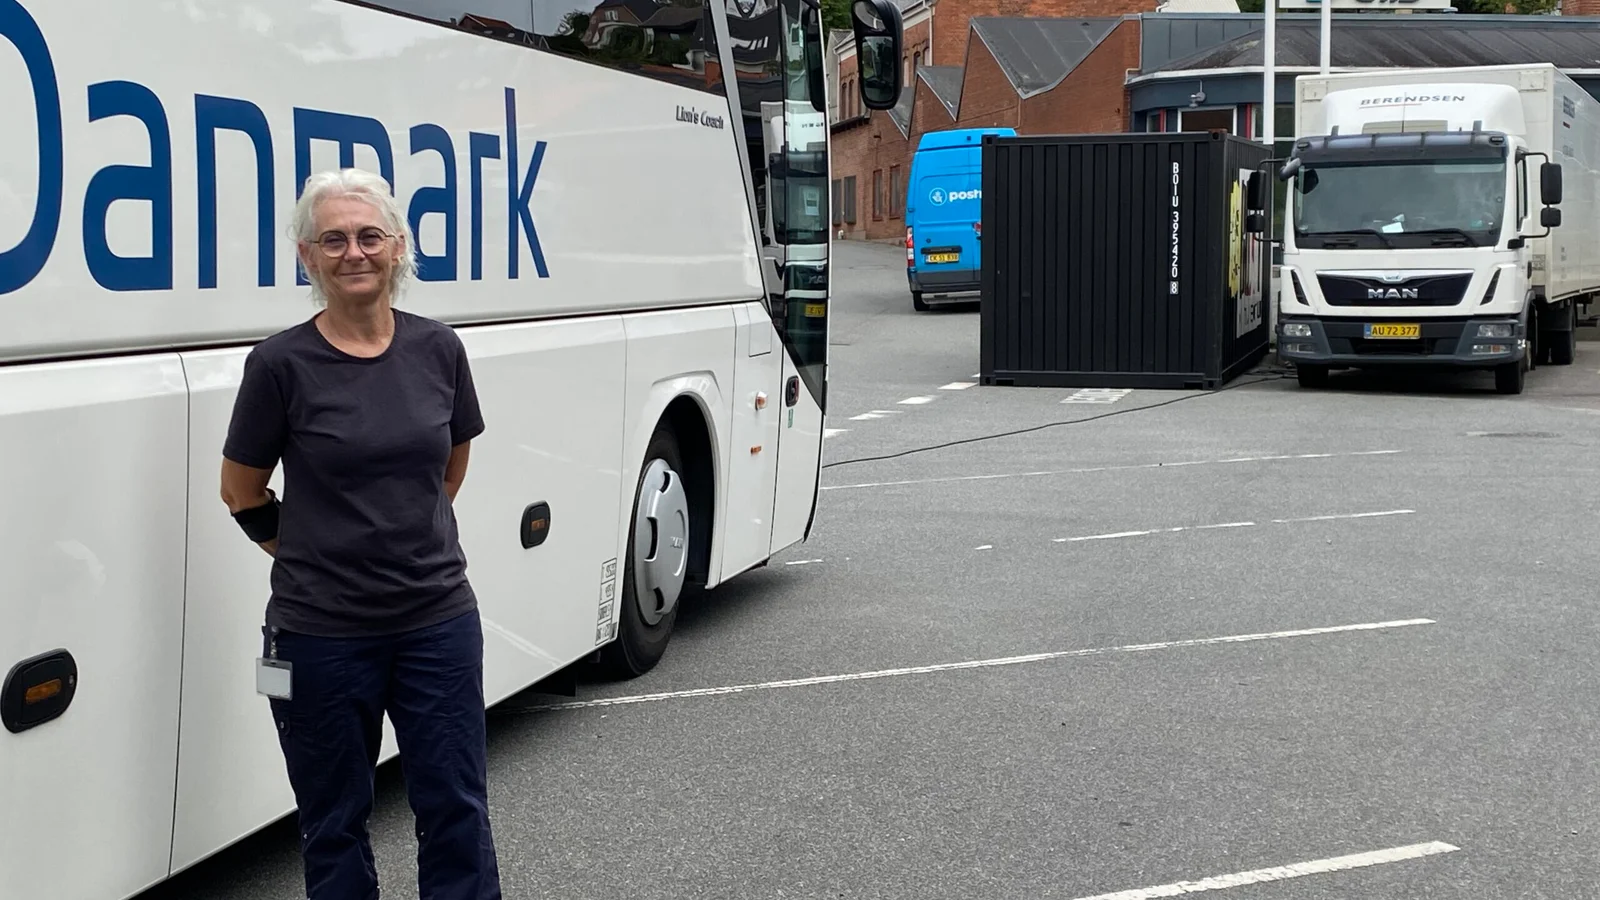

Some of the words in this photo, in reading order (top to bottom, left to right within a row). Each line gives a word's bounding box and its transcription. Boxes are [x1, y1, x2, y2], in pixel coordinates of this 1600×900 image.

[1360, 95, 1465, 105] BERENDSEN
[676, 105, 699, 124] Lion's
[700, 110, 723, 129] Coach
[1171, 211, 1179, 278] 395420
[1171, 282, 1178, 294] 8
[1368, 288, 1418, 299] MAN
[1372, 326, 1385, 336] AU
[1387, 326, 1399, 336] 72
[1400, 326, 1418, 336] 377
